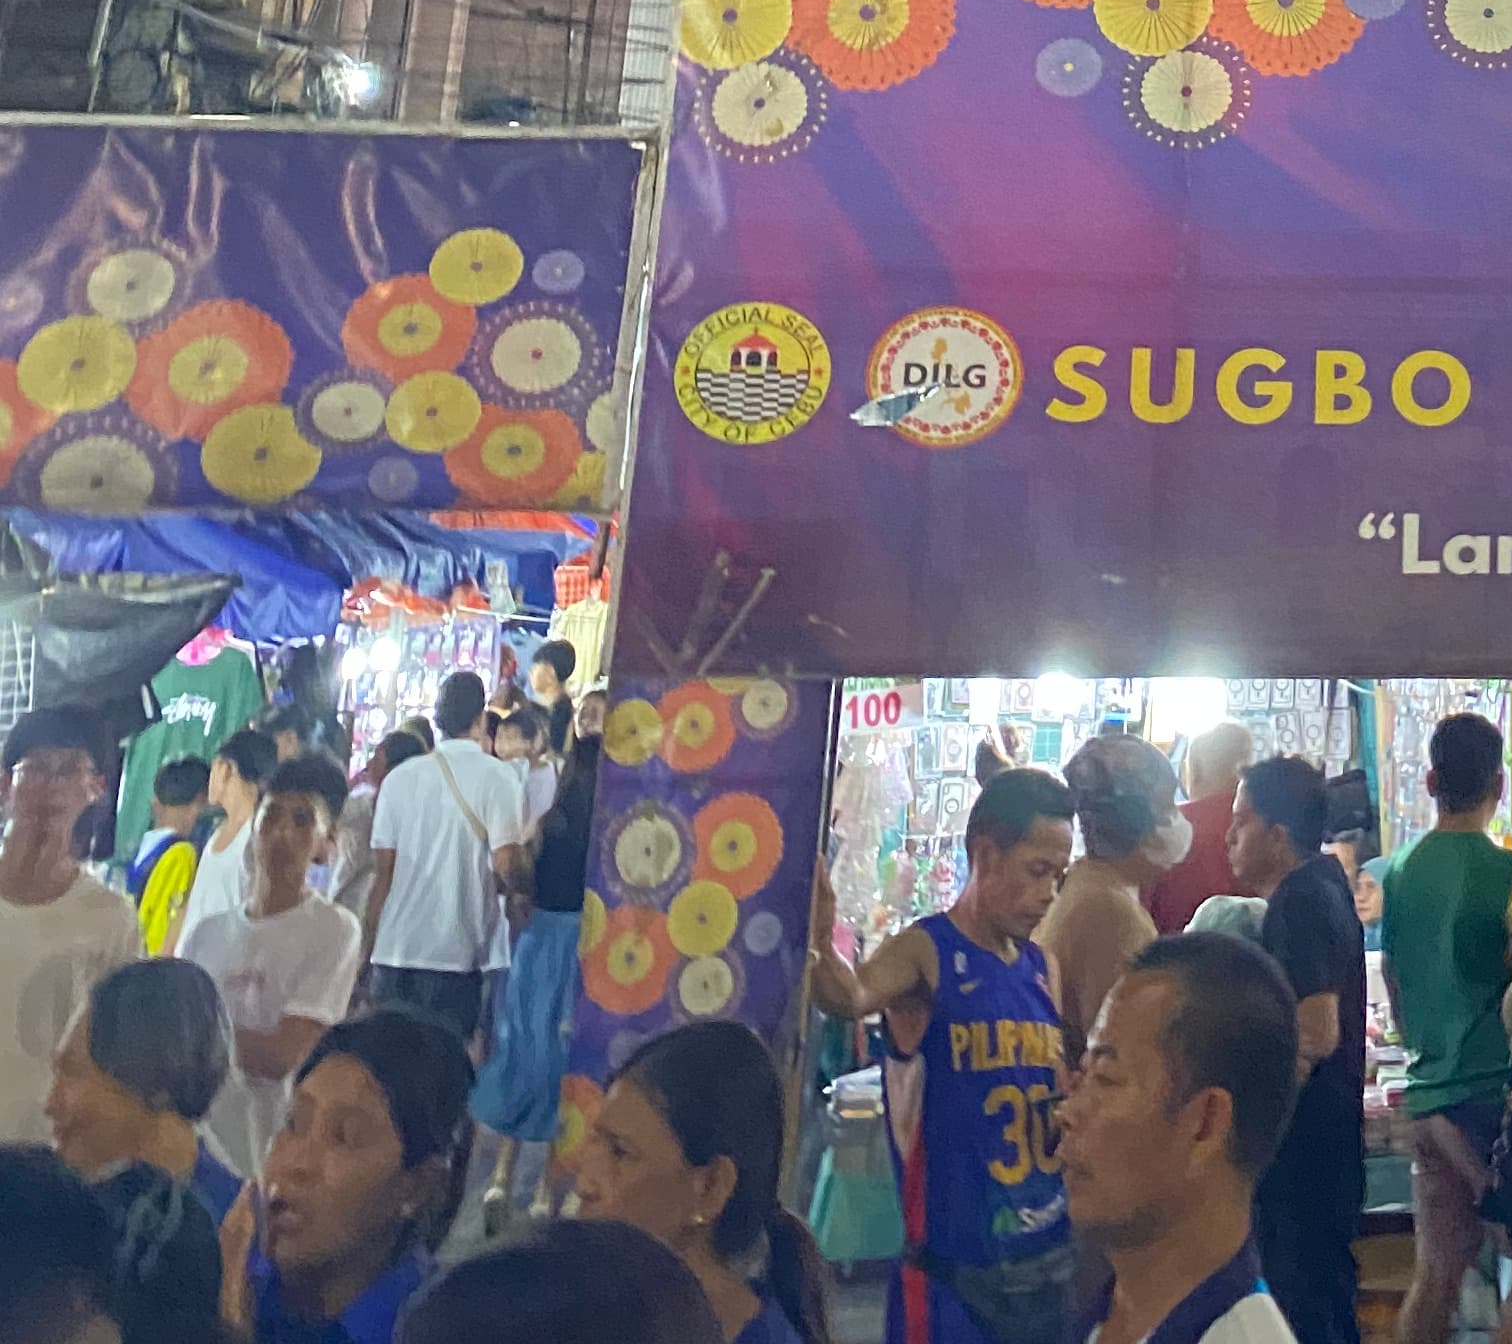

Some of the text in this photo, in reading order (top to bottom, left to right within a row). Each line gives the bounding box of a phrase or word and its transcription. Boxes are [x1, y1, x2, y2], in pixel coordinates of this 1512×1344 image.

[903, 362, 987, 389] DILG
[1045, 343, 1473, 429] SUGBO
[845, 691, 902, 730] 100
